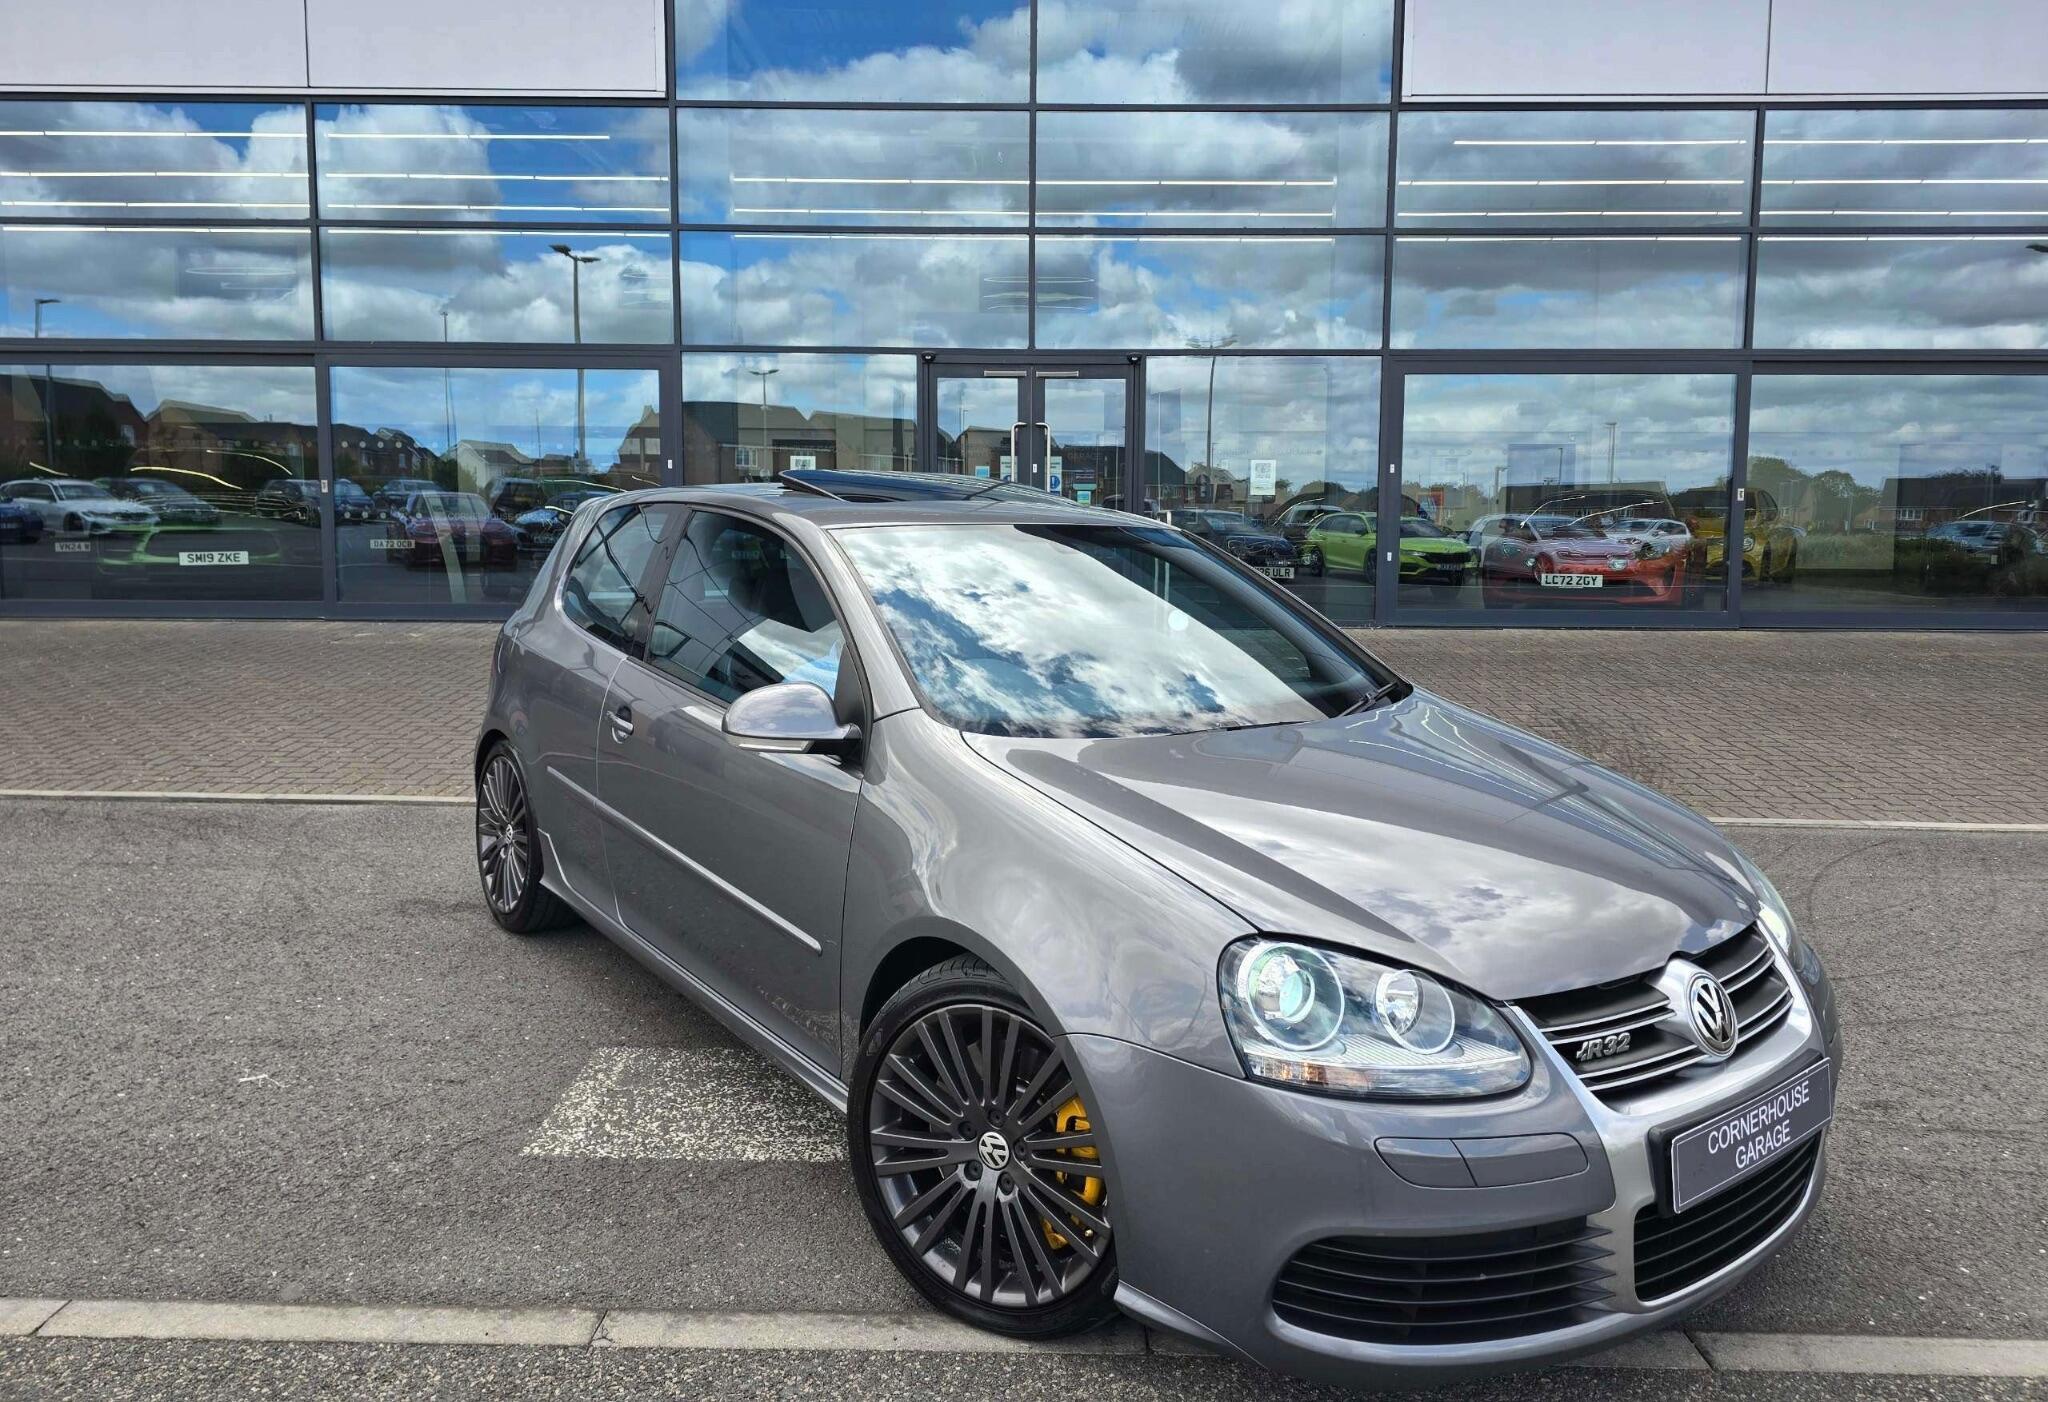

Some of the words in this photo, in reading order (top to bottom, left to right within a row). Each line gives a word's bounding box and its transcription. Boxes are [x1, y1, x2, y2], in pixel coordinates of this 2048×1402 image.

[187, 553, 214, 563] SM19
[217, 552, 241, 562] ZKE
[1273, 568, 1291, 577] ULR
[1545, 575, 1573, 585] LC72
[1575, 575, 1598, 586] ZGY
[1586, 1031, 1632, 1061] R32
[1707, 1080, 1810, 1154] CORNERHOUSE
[1735, 1120, 1791, 1169] GARAGE
